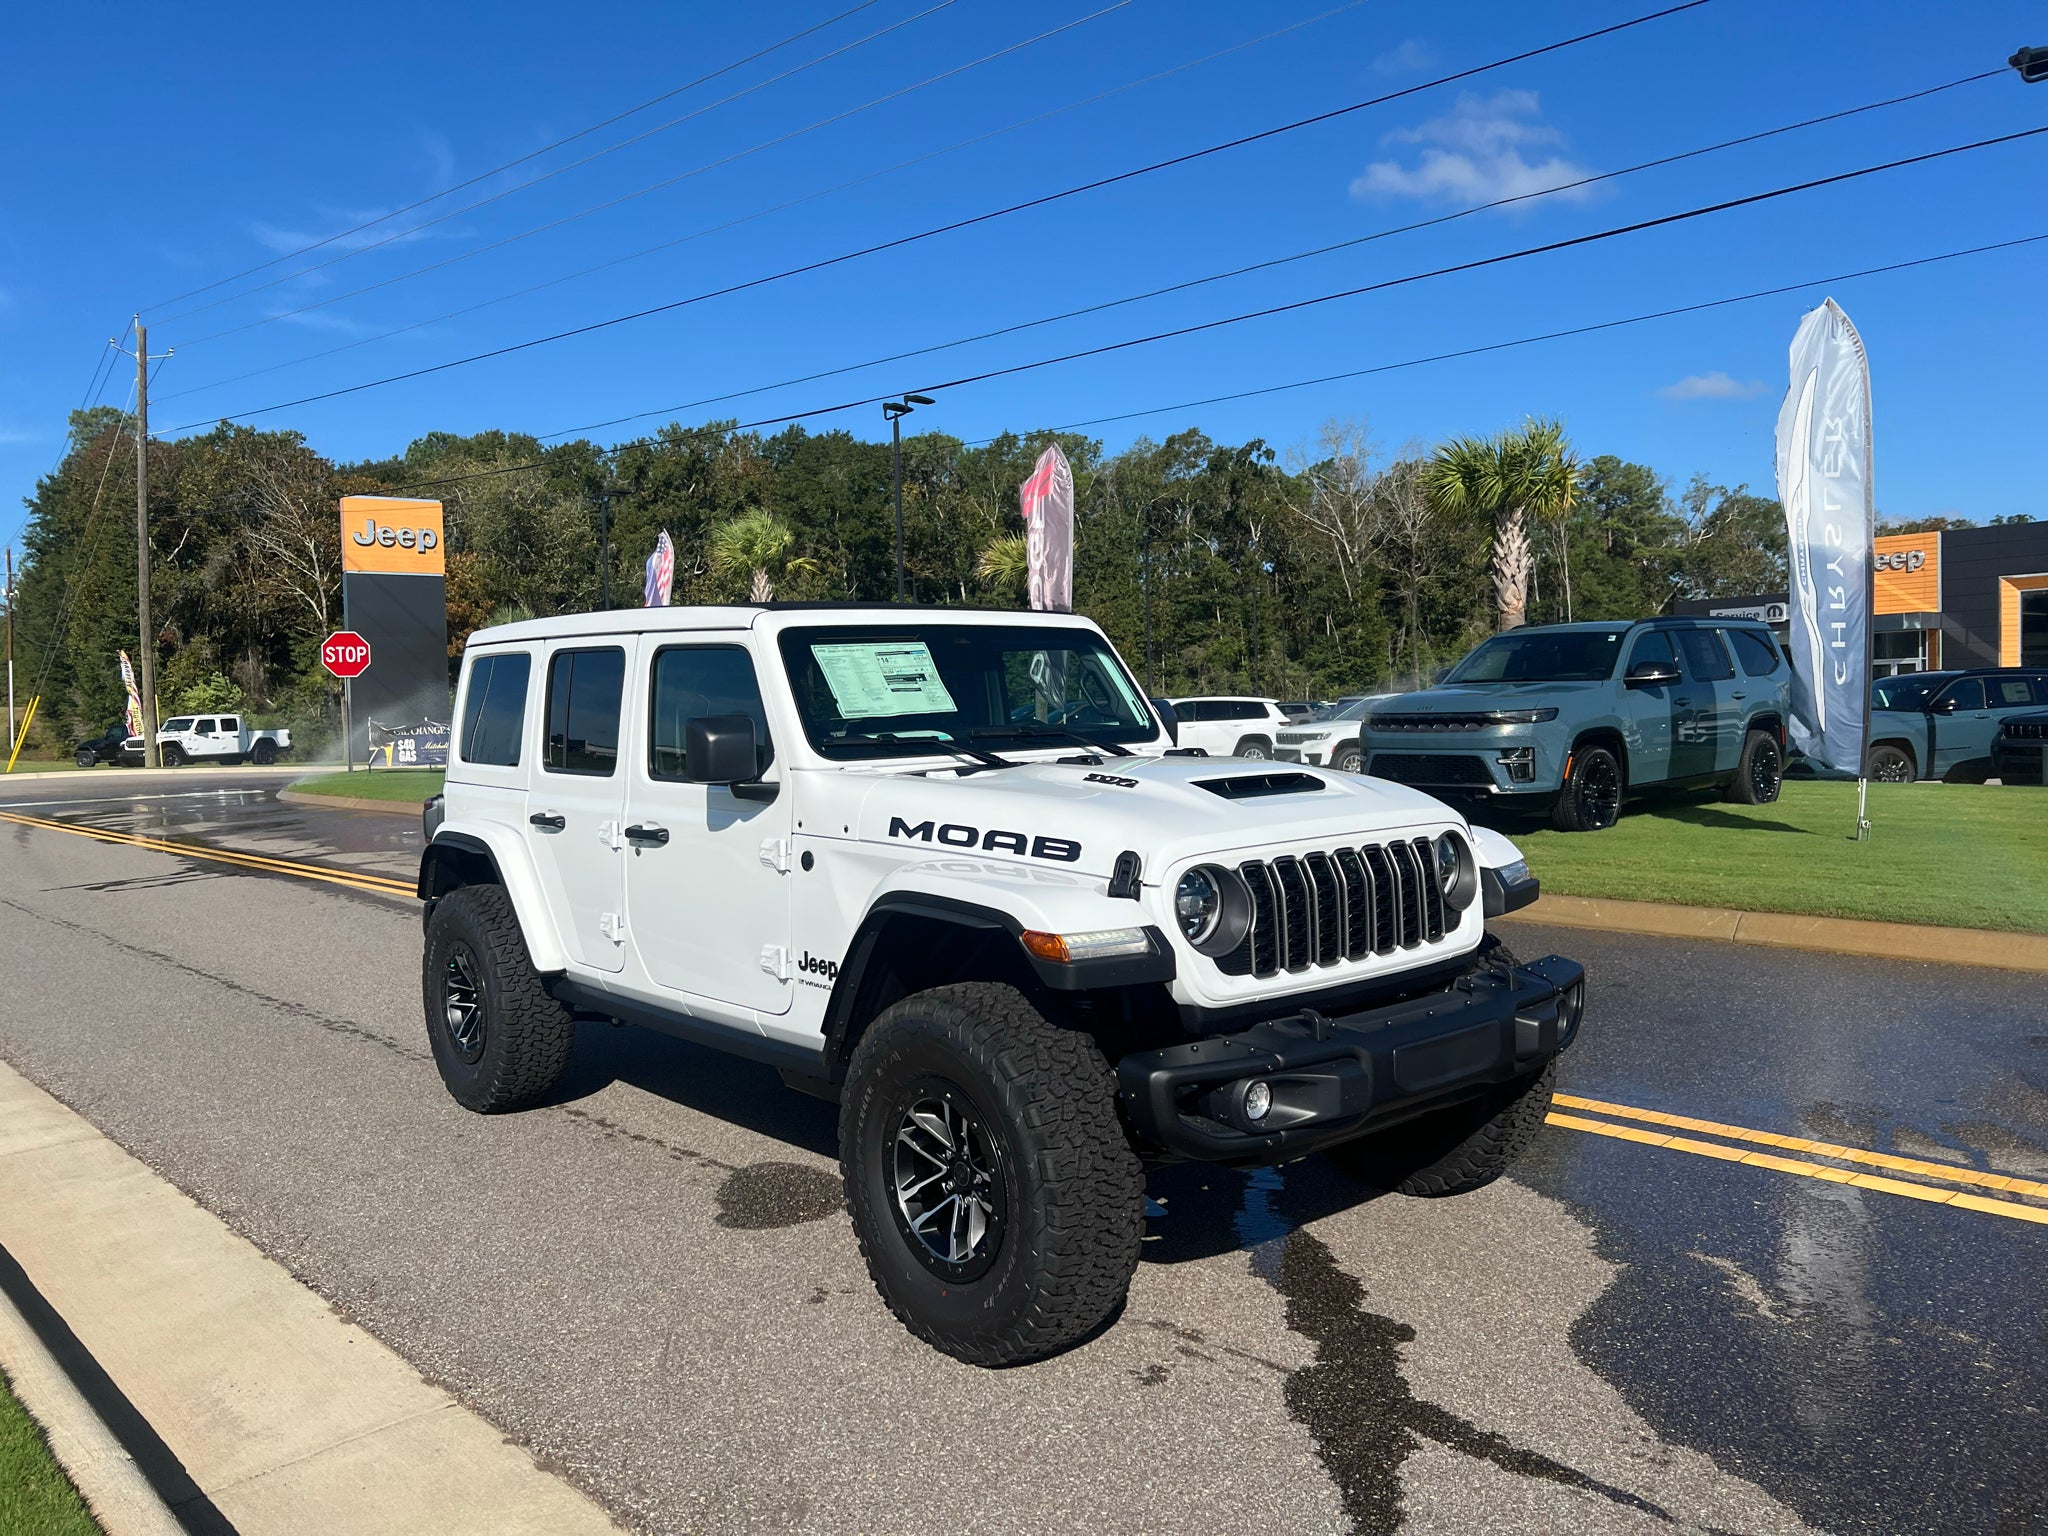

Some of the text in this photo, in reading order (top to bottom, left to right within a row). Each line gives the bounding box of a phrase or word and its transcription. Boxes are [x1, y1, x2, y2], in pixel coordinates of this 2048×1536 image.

[353, 519, 437, 554] Jeep
[1873, 550, 1925, 573] eep
[1716, 611, 1760, 619] vice
[325, 646, 367, 663] STOP
[410, 726, 446, 736] CHANGE
[397, 738, 416, 751] $40
[398, 750, 417, 763] GAS
[888, 816, 1082, 863] MOAB
[798, 950, 839, 982] Jeep
